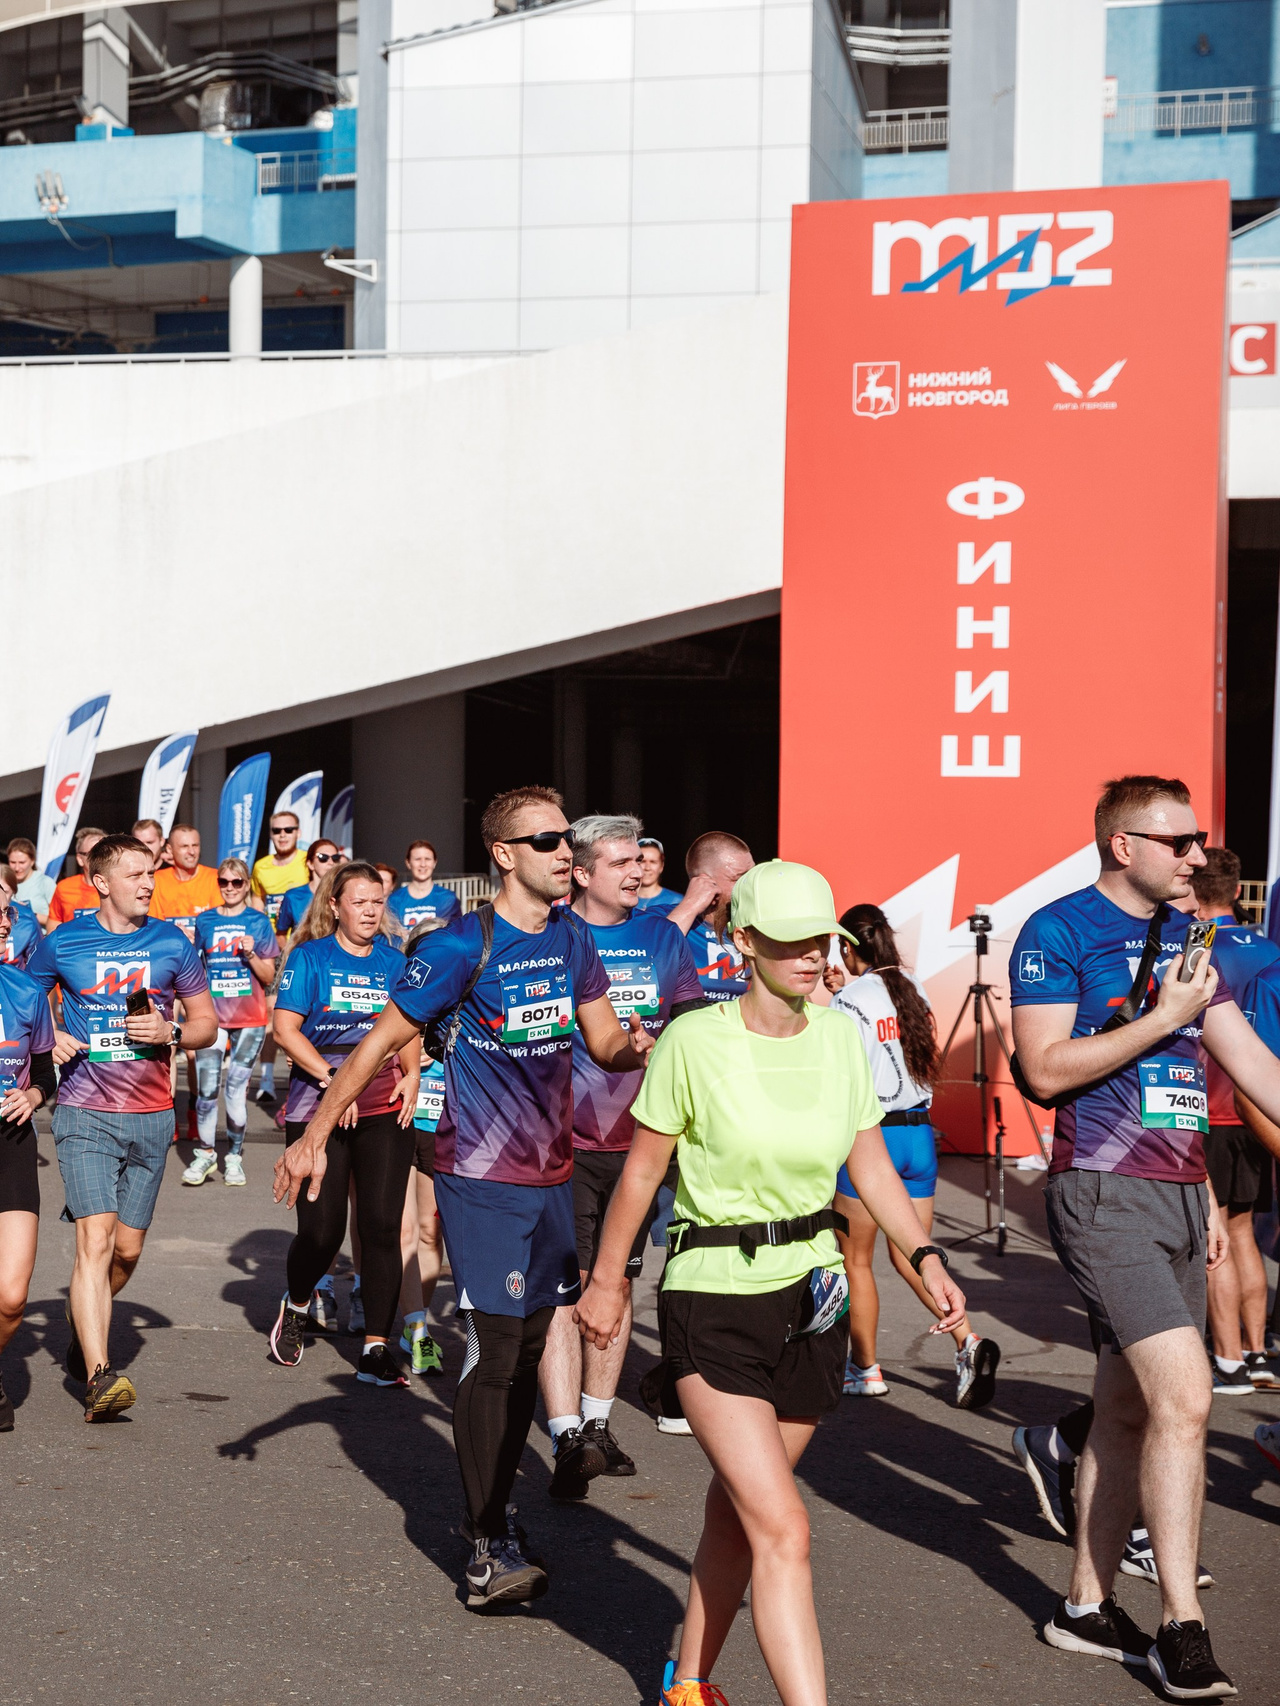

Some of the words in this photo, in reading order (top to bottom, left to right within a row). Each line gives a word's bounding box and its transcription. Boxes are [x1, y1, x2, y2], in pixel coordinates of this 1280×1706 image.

[908, 367, 992, 388] НИЖНИЙ
[908, 388, 1009, 408] НОВГОРОД
[940, 477, 1025, 778] ФИНИШ
[96, 950, 150, 958] МАРАФОН
[598, 949, 647, 957] РАФОН
[341, 990, 381, 1001] 6545
[608, 990, 647, 1002] 280
[521, 1004, 560, 1024] 8071
[529, 1030, 537, 1038] 5
[1165, 1093, 1200, 1110] 7410
[1178, 1118, 1185, 1126] 5
